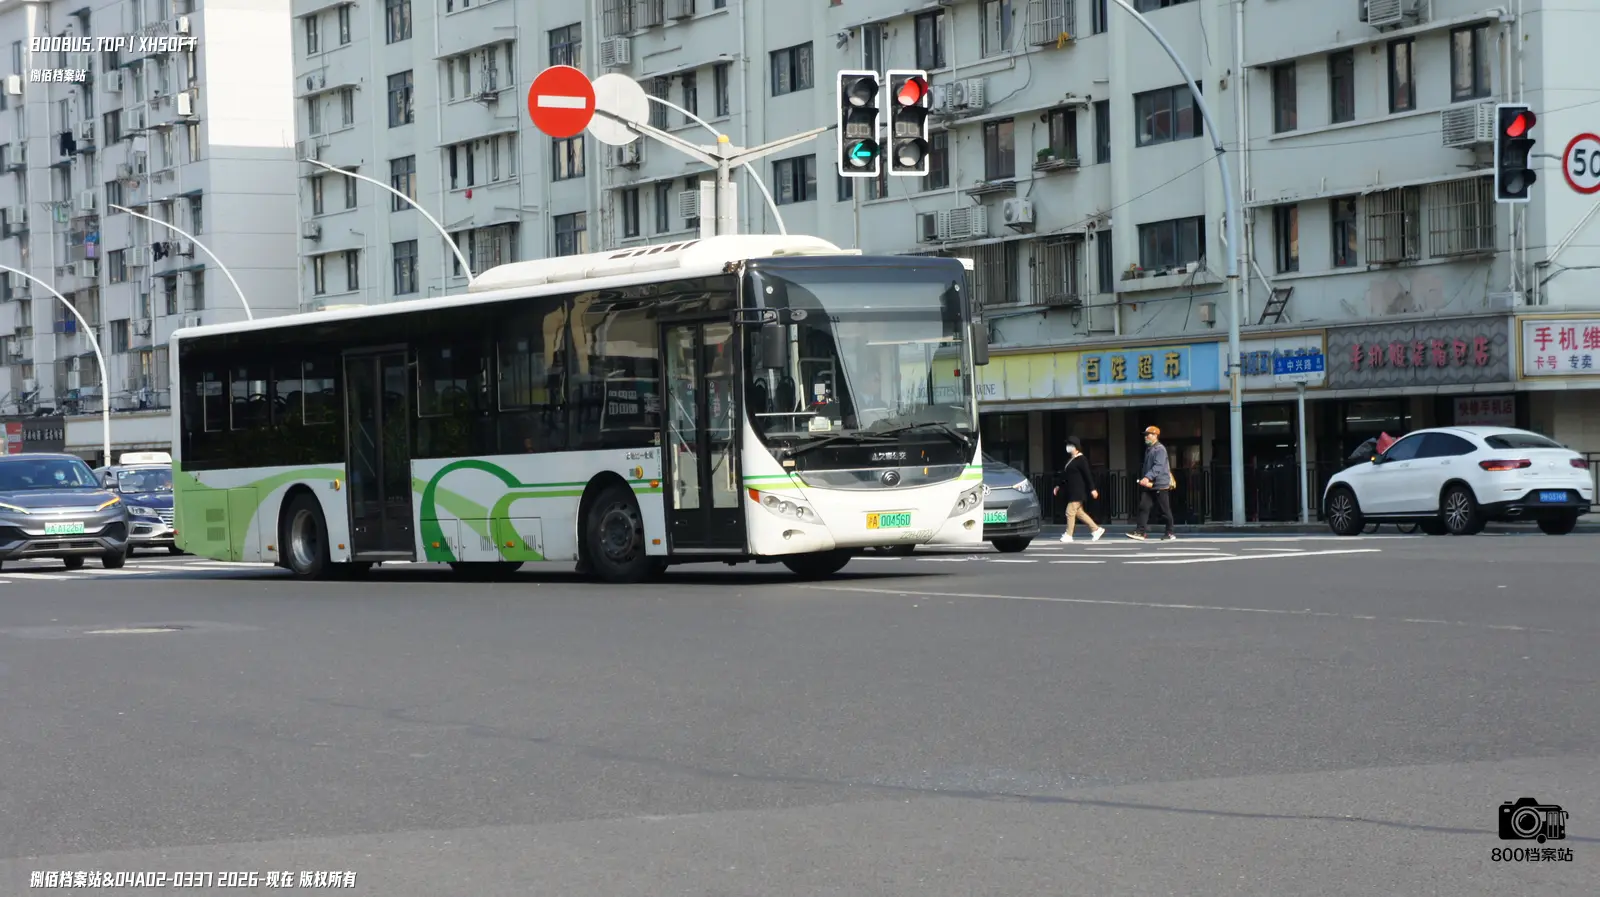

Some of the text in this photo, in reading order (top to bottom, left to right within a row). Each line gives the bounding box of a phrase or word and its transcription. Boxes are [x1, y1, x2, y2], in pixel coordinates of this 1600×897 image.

[1573, 148, 1600, 178] 50
[1533, 326, 1600, 352] 手机维
[1086, 351, 1180, 382] 百姓超市
[1286, 358, 1312, 372] 中兴路
[1533, 354, 1592, 369] 卡号 专卖
[976, 383, 996, 396] WINE
